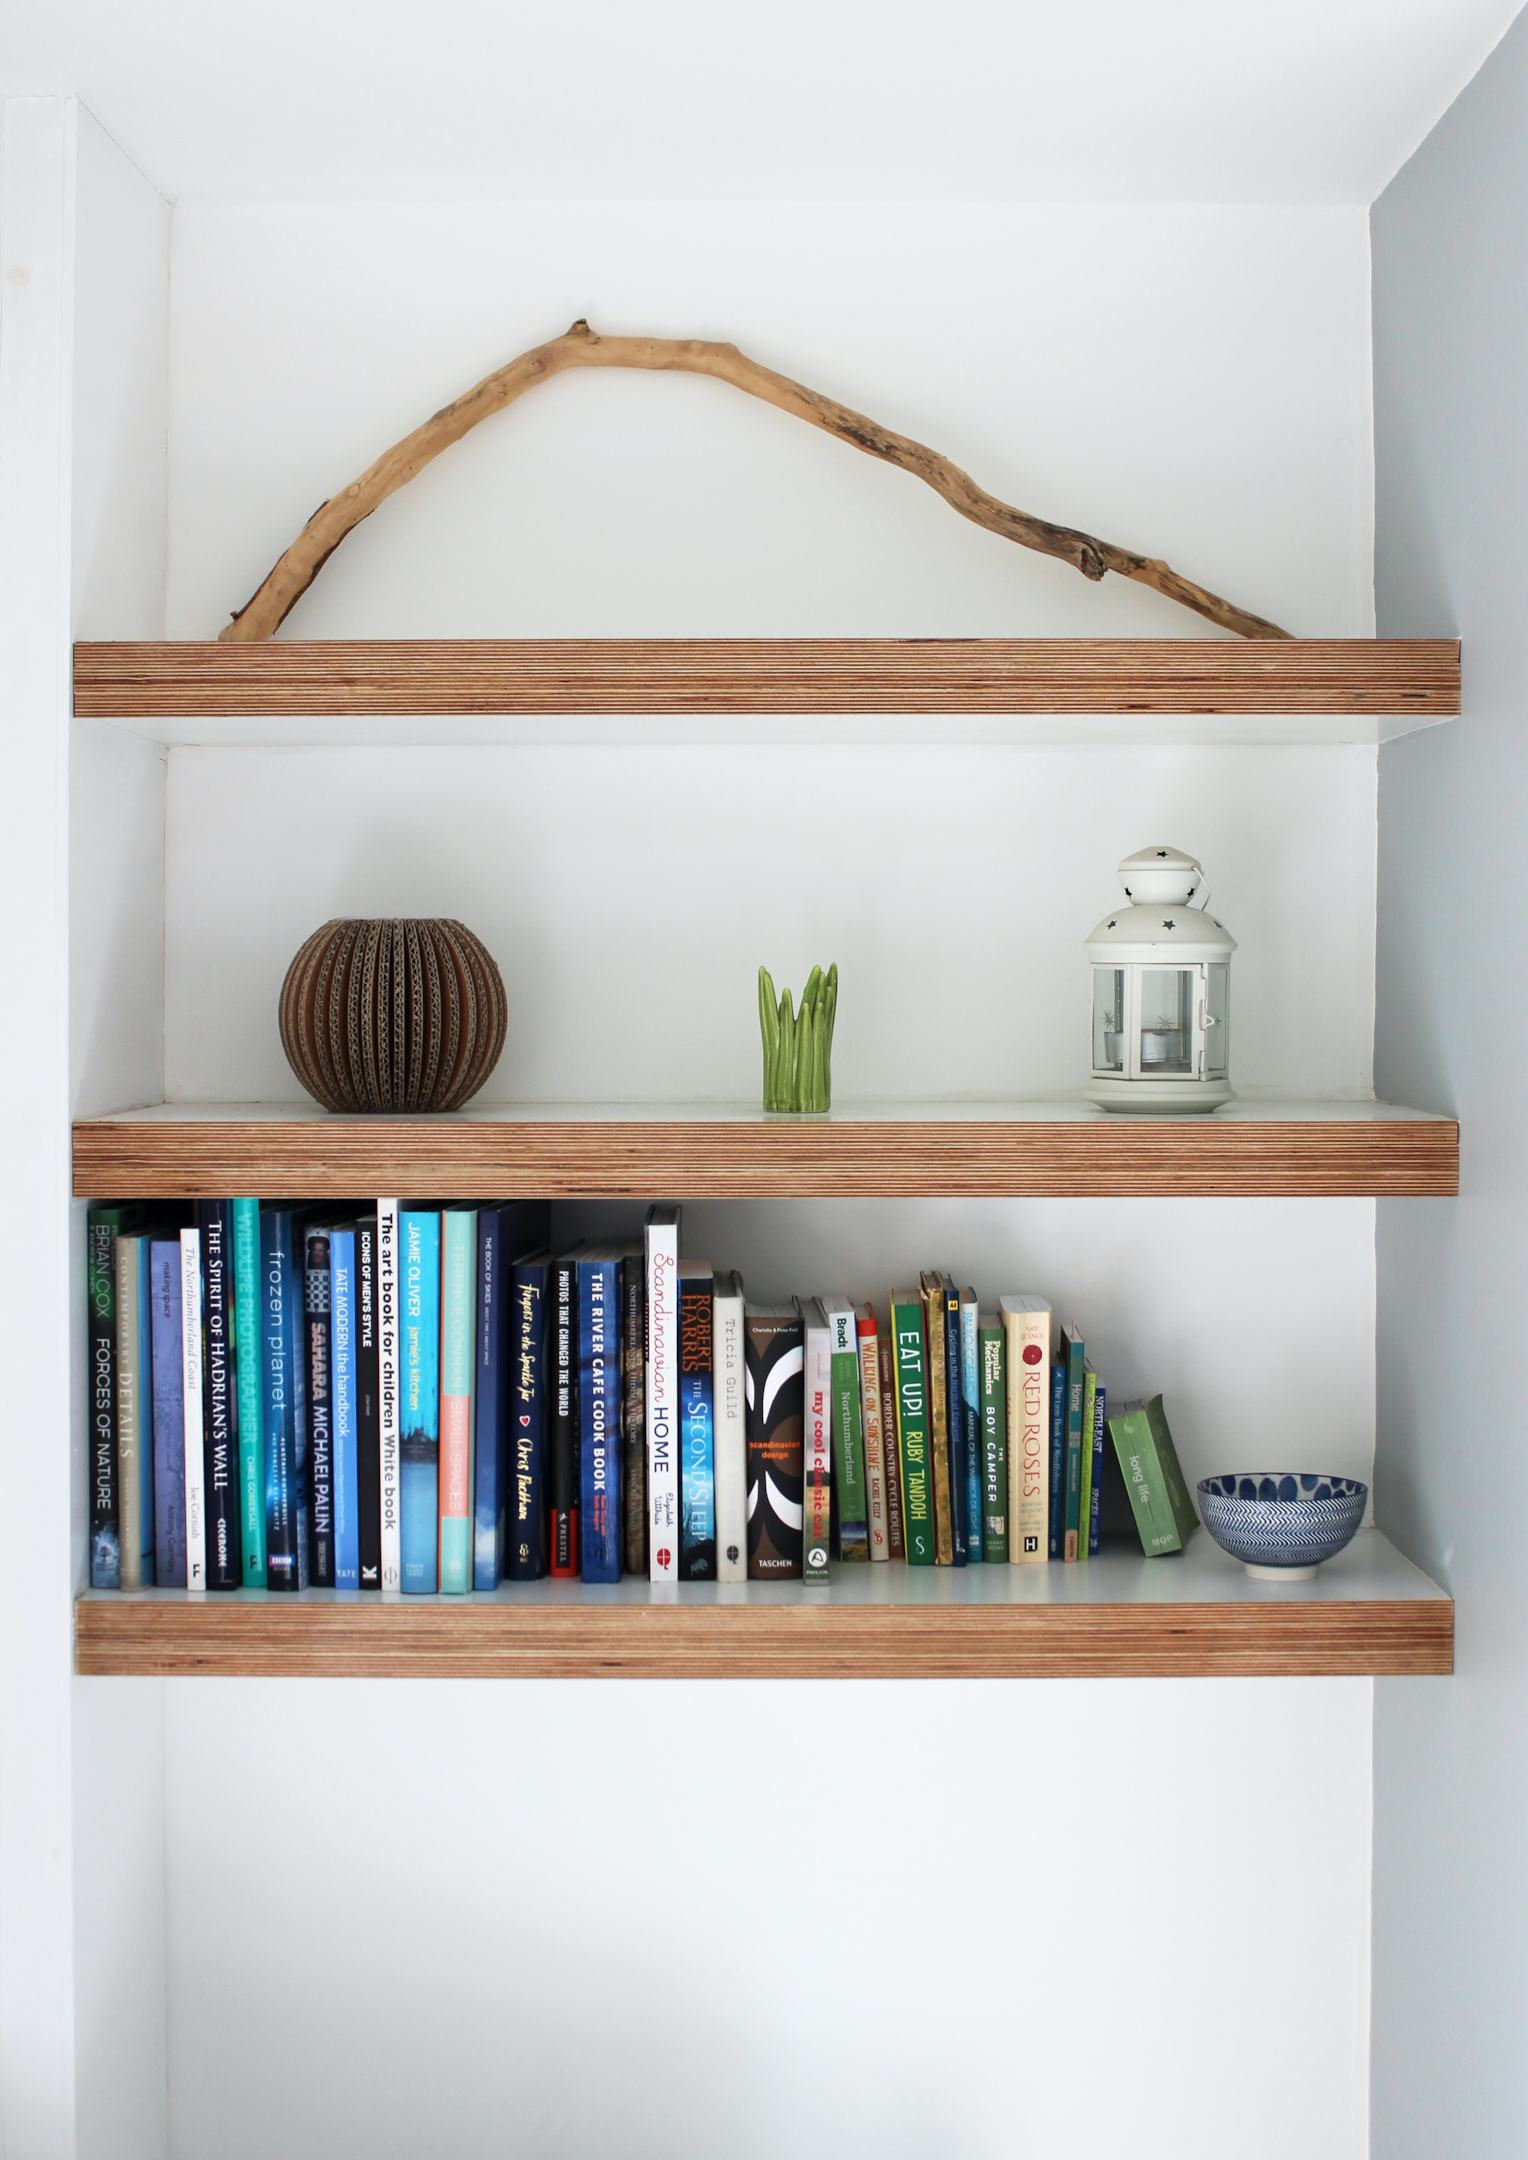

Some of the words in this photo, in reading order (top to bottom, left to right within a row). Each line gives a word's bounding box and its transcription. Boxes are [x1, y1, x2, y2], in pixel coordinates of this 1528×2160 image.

[208, 1220, 222, 1254] THE
[382, 1213, 393, 1244] The
[408, 1222, 420, 1263] JAMIE
[96, 1225, 110, 1274] BRIAN
[186, 1247, 195, 1268] The
[237, 1212, 254, 1293] WILDLIFE
[361, 1231, 371, 1263] ICONS
[382, 1250, 392, 1276] art
[162, 1262, 172, 1293] making
[209, 1260, 222, 1310] SPIRIT
[269, 1250, 284, 1326] frozen
[336, 1268, 348, 1293] TATE
[362, 1265, 371, 1279] OF
[450, 1244, 465, 1317] TERENCE
[485, 1273, 492, 1282] OF
[558, 1271, 569, 1302] PHOTOS
[591, 1272, 604, 1301] THE
[96, 1280, 110, 1317] COX
[163, 1294, 172, 1318] space
[362, 1281, 371, 1312] MEN'S
[382, 1282, 394, 1325] book
[408, 1266, 420, 1316] OLIVER
[516, 1284, 540, 1321] Fingers
[120, 1257, 129, 1365] CONTEMPORARY
[186, 1270, 196, 1357] Northumberland
[210, 1315, 222, 1337] OF
[336, 1296, 348, 1350] MODERN
[522, 1322, 533, 1333] in
[559, 1306, 569, 1325] THAT
[654, 1253, 674, 1402] Scandinavian
[963, 1312, 973, 1345] PAULO
[363, 1314, 372, 1347] STYLE
[383, 1331, 394, 1356] for
[407, 1326, 421, 1365] jamie's
[521, 1336, 536, 1350] the
[559, 1328, 569, 1366] CHANGED
[592, 1307, 604, 1352] RIVER
[682, 1294, 698, 1372] HARRIS
[696, 1294, 711, 1371] ROBERT
[725, 1319, 736, 1368] Tricia
[836, 1318, 848, 1348] Bradt
[949, 1329, 958, 1355] Cycling
[311, 1322, 327, 1401] SAHARA
[338, 1353, 349, 1372] the
[451, 1319, 464, 1388] CONRAN
[862, 1342, 877, 1393] WALKING
[899, 1331, 921, 1372] EAT
[984, 1340, 993, 1395] Mechanics
[990, 1340, 1001, 1381] Popular
[96, 1338, 110, 1408] FORCES
[187, 1360, 197, 1390] Coast
[239, 1299, 258, 1443] PHOTOGRAPHER
[268, 1337, 287, 1410] planet
[517, 1353, 536, 1387] Sparkle
[559, 1369, 569, 1384] THE
[592, 1358, 605, 1394] CAFE
[963, 1348, 974, 1394] COELHO
[211, 1342, 227, 1439] HADRIAN'S
[338, 1376, 350, 1437] handbook
[383, 1361, 395, 1428] children
[409, 1368, 421, 1410] kitchen
[516, 1388, 535, 1402] Jar
[558, 1387, 569, 1416] WORLD
[629, 1372, 637, 1407] HIDDEN
[693, 1380, 702, 1399] THE
[726, 1377, 737, 1418] Guild
[812, 1391, 824, 1416] my
[865, 1397, 877, 1412] ON
[902, 1383, 923, 1417] UP!
[952, 1402, 959, 1410] of
[1022, 1371, 1041, 1416] RED
[1054, 1385, 1063, 1399] The
[1071, 1383, 1082, 1411] Home
[97, 1414, 110, 1438] OF
[119, 1373, 133, 1457] DETAILS
[450, 1400, 463, 1449] SMALL
[592, 1399, 605, 1442] COOK
[629, 1408, 637, 1443] HISTORY
[882, 1392, 893, 1430] BORDER
[967, 1411, 976, 1441] MANUAL
[986, 1406, 996, 1434] BOY
[1054, 1400, 1062, 1416] Little
[1093, 1395, 1104, 1453] NORTH-EAST
[313, 1406, 328, 1482] MICHAEL
[654, 1407, 669, 1473] HOME
[687, 1402, 708, 1484] SECOND
[749, 1441, 800, 1449] scandinavian
[814, 1420, 826, 1453] cool
[841, 1392, 855, 1485] Northumberland
[866, 1417, 879, 1471] SUNSHINE
[951, 1412, 960, 1442] England
[1053, 1439, 1061, 1447] of
[1054, 1418, 1062, 1437] Book
[384, 1434, 396, 1481] White
[517, 1438, 533, 1471] Chris
[761, 1451, 789, 1460] design
[885, 1432, 895, 1478] COUNTRY
[905, 1431, 924, 1464] RUBY
[969, 1442, 976, 1452] OF
[1022, 1424, 1041, 1497] ROSES
[97, 1443, 111, 1510] NATURE
[213, 1443, 227, 1491] WALL
[247, 1456, 255, 1480] CHRIS
[449, 1453, 462, 1511] SPACES
[593, 1447, 606, 1490] BOOK
[629, 1469, 637, 1487] STAN
[969, 1467, 977, 1498] WARRIOR
[986, 1442, 997, 1502] CAMPER
[1052, 1449, 1061, 1493] Mindfulness
[1129, 1455, 1145, 1483] long
[1137, 1484, 1150, 1503] life
[189, 1487, 199, 1501] Joe
[516, 1474, 532, 1520] Packham
[813, 1458, 826, 1513] classic
[871, 1477, 881, 1499] RACHEL
[887, 1480, 898, 1508] CYCLE
[908, 1468, 927, 1520] TANDOH
[1091, 1487, 1100, 1515] SPACES
[190, 1503, 200, 1539] Cornish
[247, 1482, 256, 1531] GOMERSALL
[314, 1485, 329, 1532] PALIN
[384, 1487, 396, 1529] book
[662, 1492, 674, 1528] Elizabeth
[689, 1488, 709, 1541] SLEEP
[872, 1501, 882, 1519] KELLY
[970, 1501, 977, 1511] OF
[970, 1512, 978, 1530] LIGHT
[217, 1518, 227, 1567] CICERONE
[559, 1524, 567, 1562] PRESTEL
[890, 1510, 900, 1546] ROUTES
[1025, 1538, 1036, 1550] H
[1152, 1534, 1173, 1546] MQP
[336, 1570, 356, 1578] TATE
